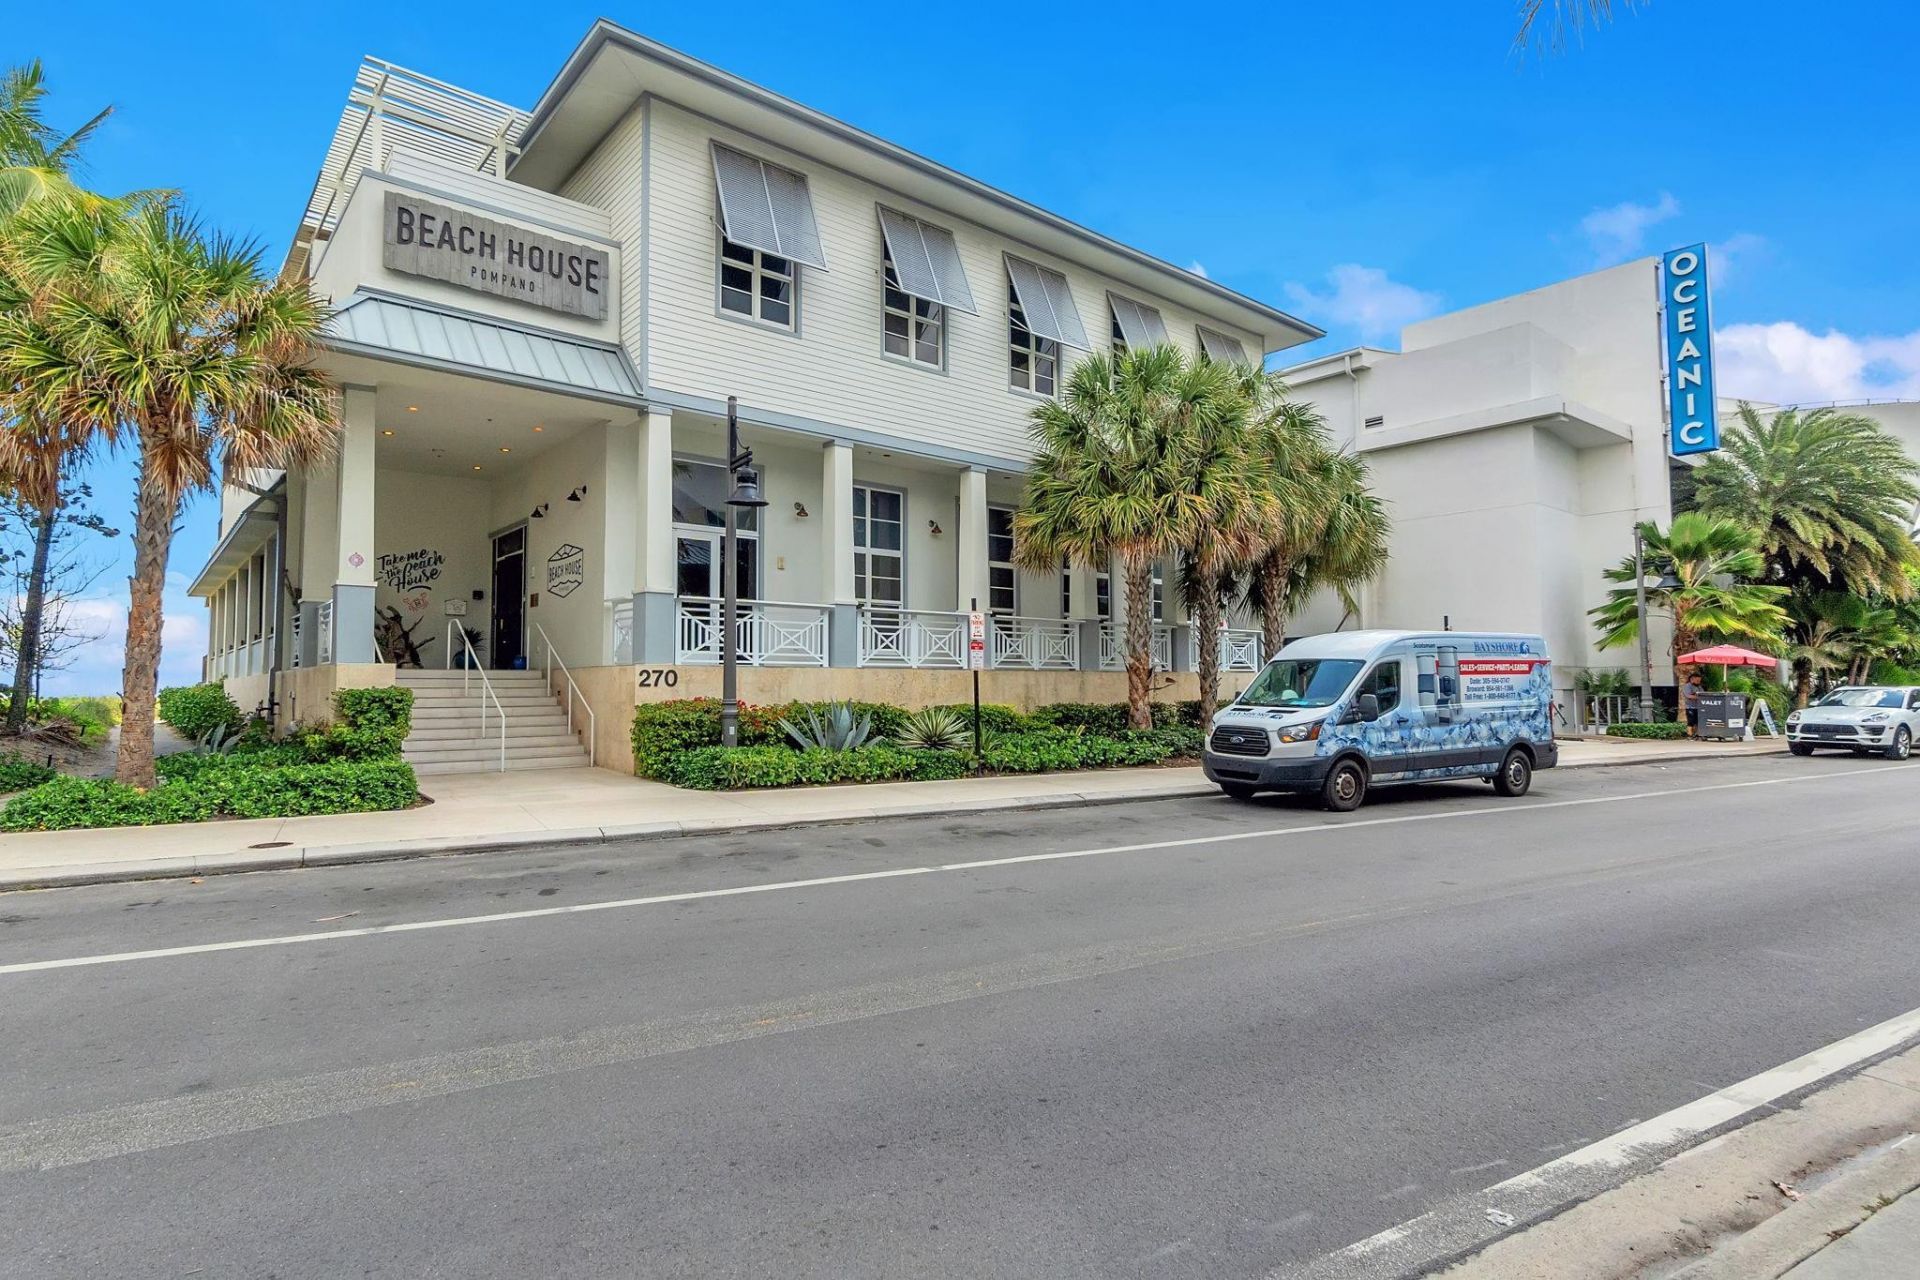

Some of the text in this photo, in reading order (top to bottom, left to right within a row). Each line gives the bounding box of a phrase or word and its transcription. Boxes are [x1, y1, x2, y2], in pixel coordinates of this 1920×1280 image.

[396, 206, 599, 294] BEACH HOUSE
[471, 266, 535, 292] POMPANO
[1670, 251, 1705, 445] OCEANIC
[376, 549, 429, 570] Take me
[402, 550, 446, 577] Beach
[388, 567, 442, 593] House
[1473, 641, 1520, 652] BAYSHORE
[638, 669, 678, 687] 270
